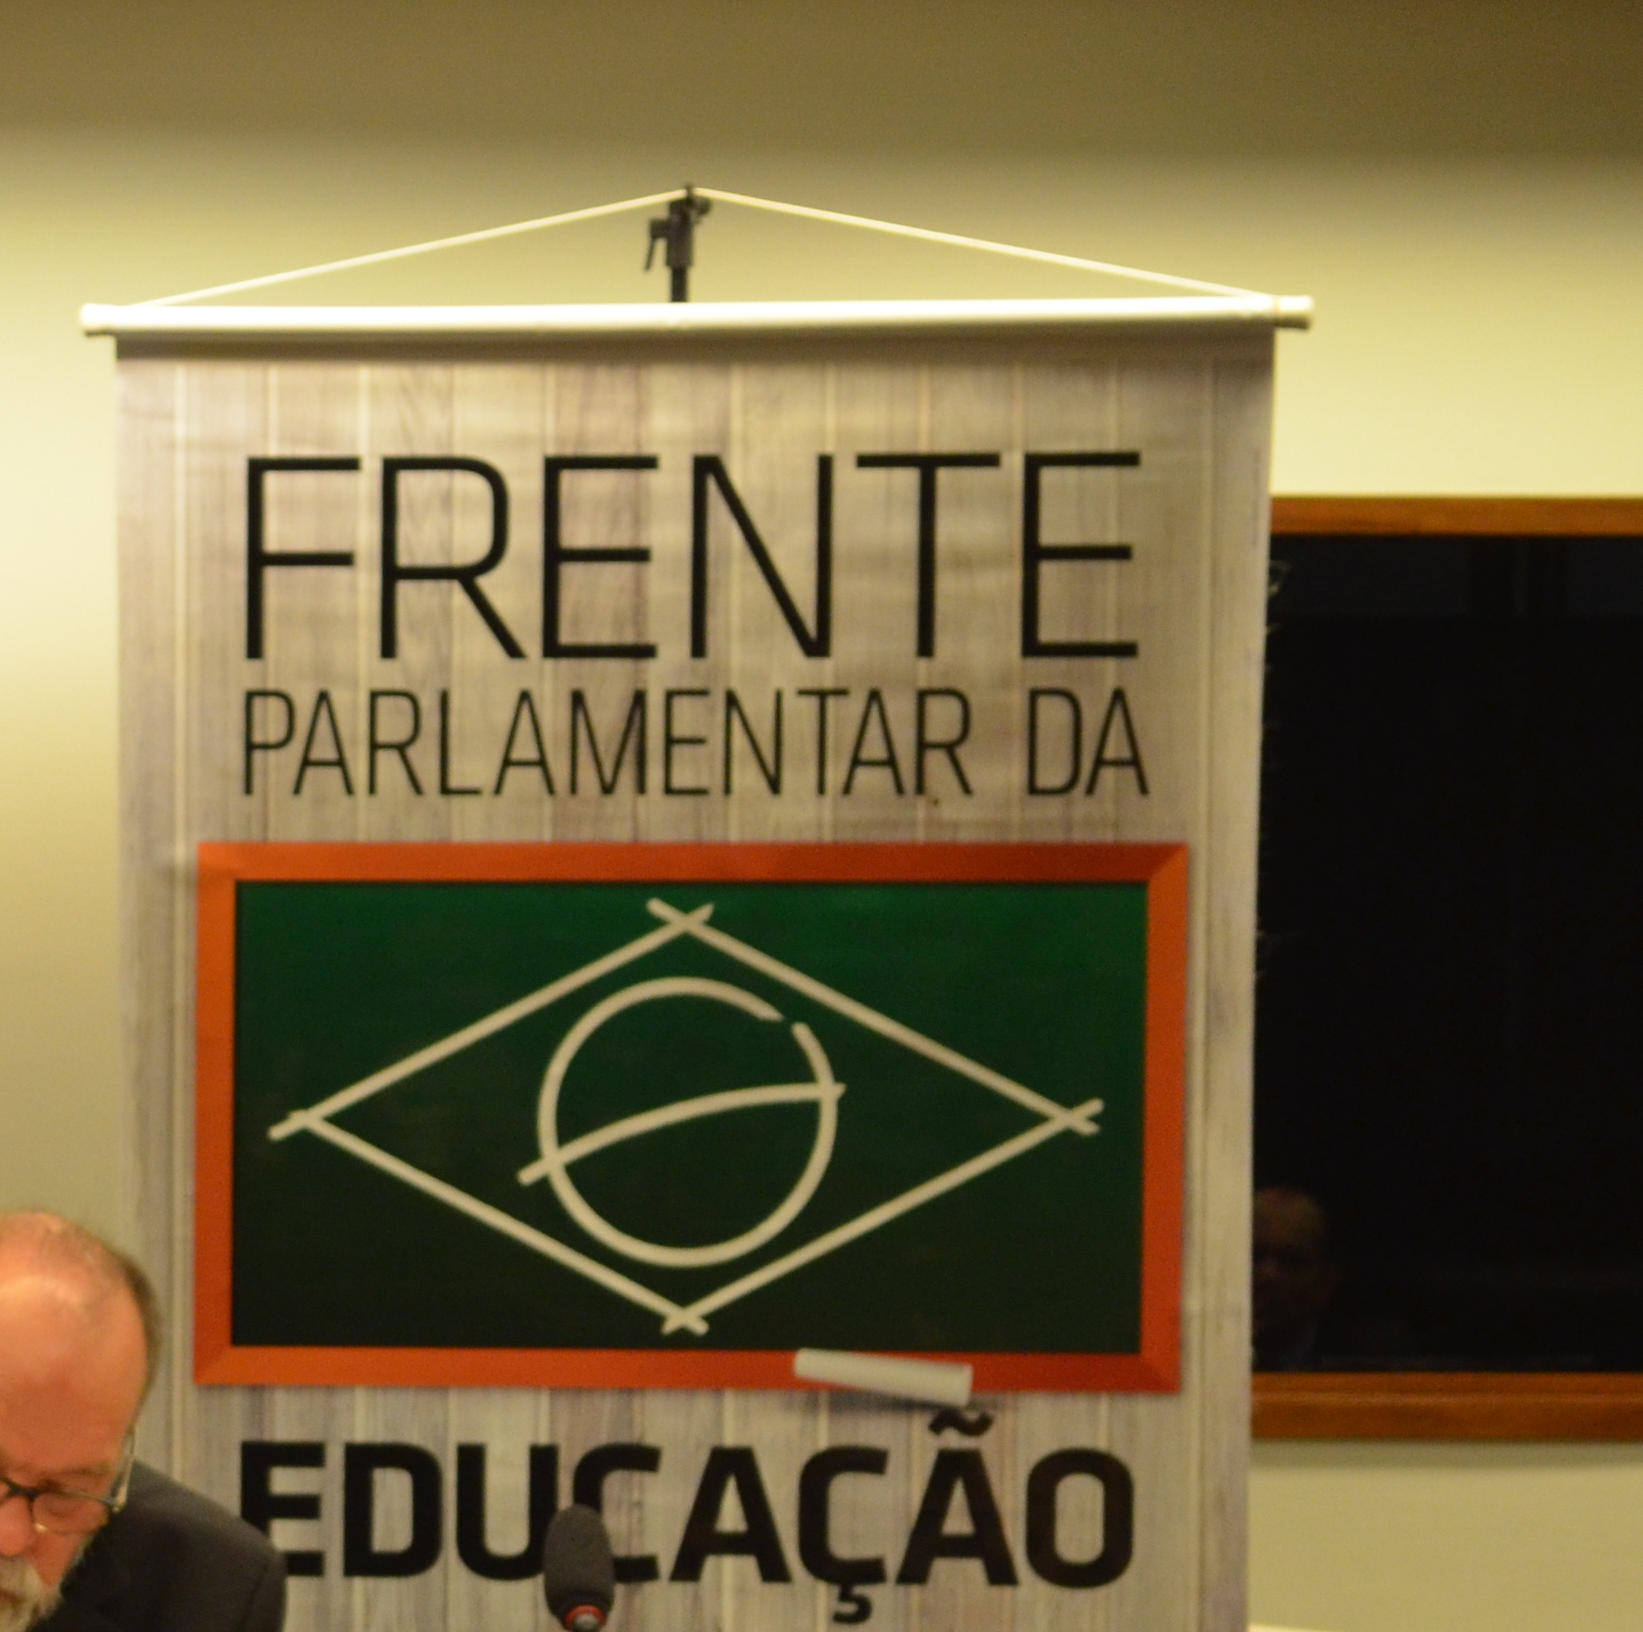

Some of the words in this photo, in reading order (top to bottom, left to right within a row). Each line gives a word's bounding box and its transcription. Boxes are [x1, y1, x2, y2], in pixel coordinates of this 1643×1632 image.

[245, 450, 1141, 661] FRENTE
[243, 687, 975, 798] PARLAMENTAR
[1025, 686, 1151, 798] DA
[240, 1405, 1136, 1625] EDUCAÇÃO
